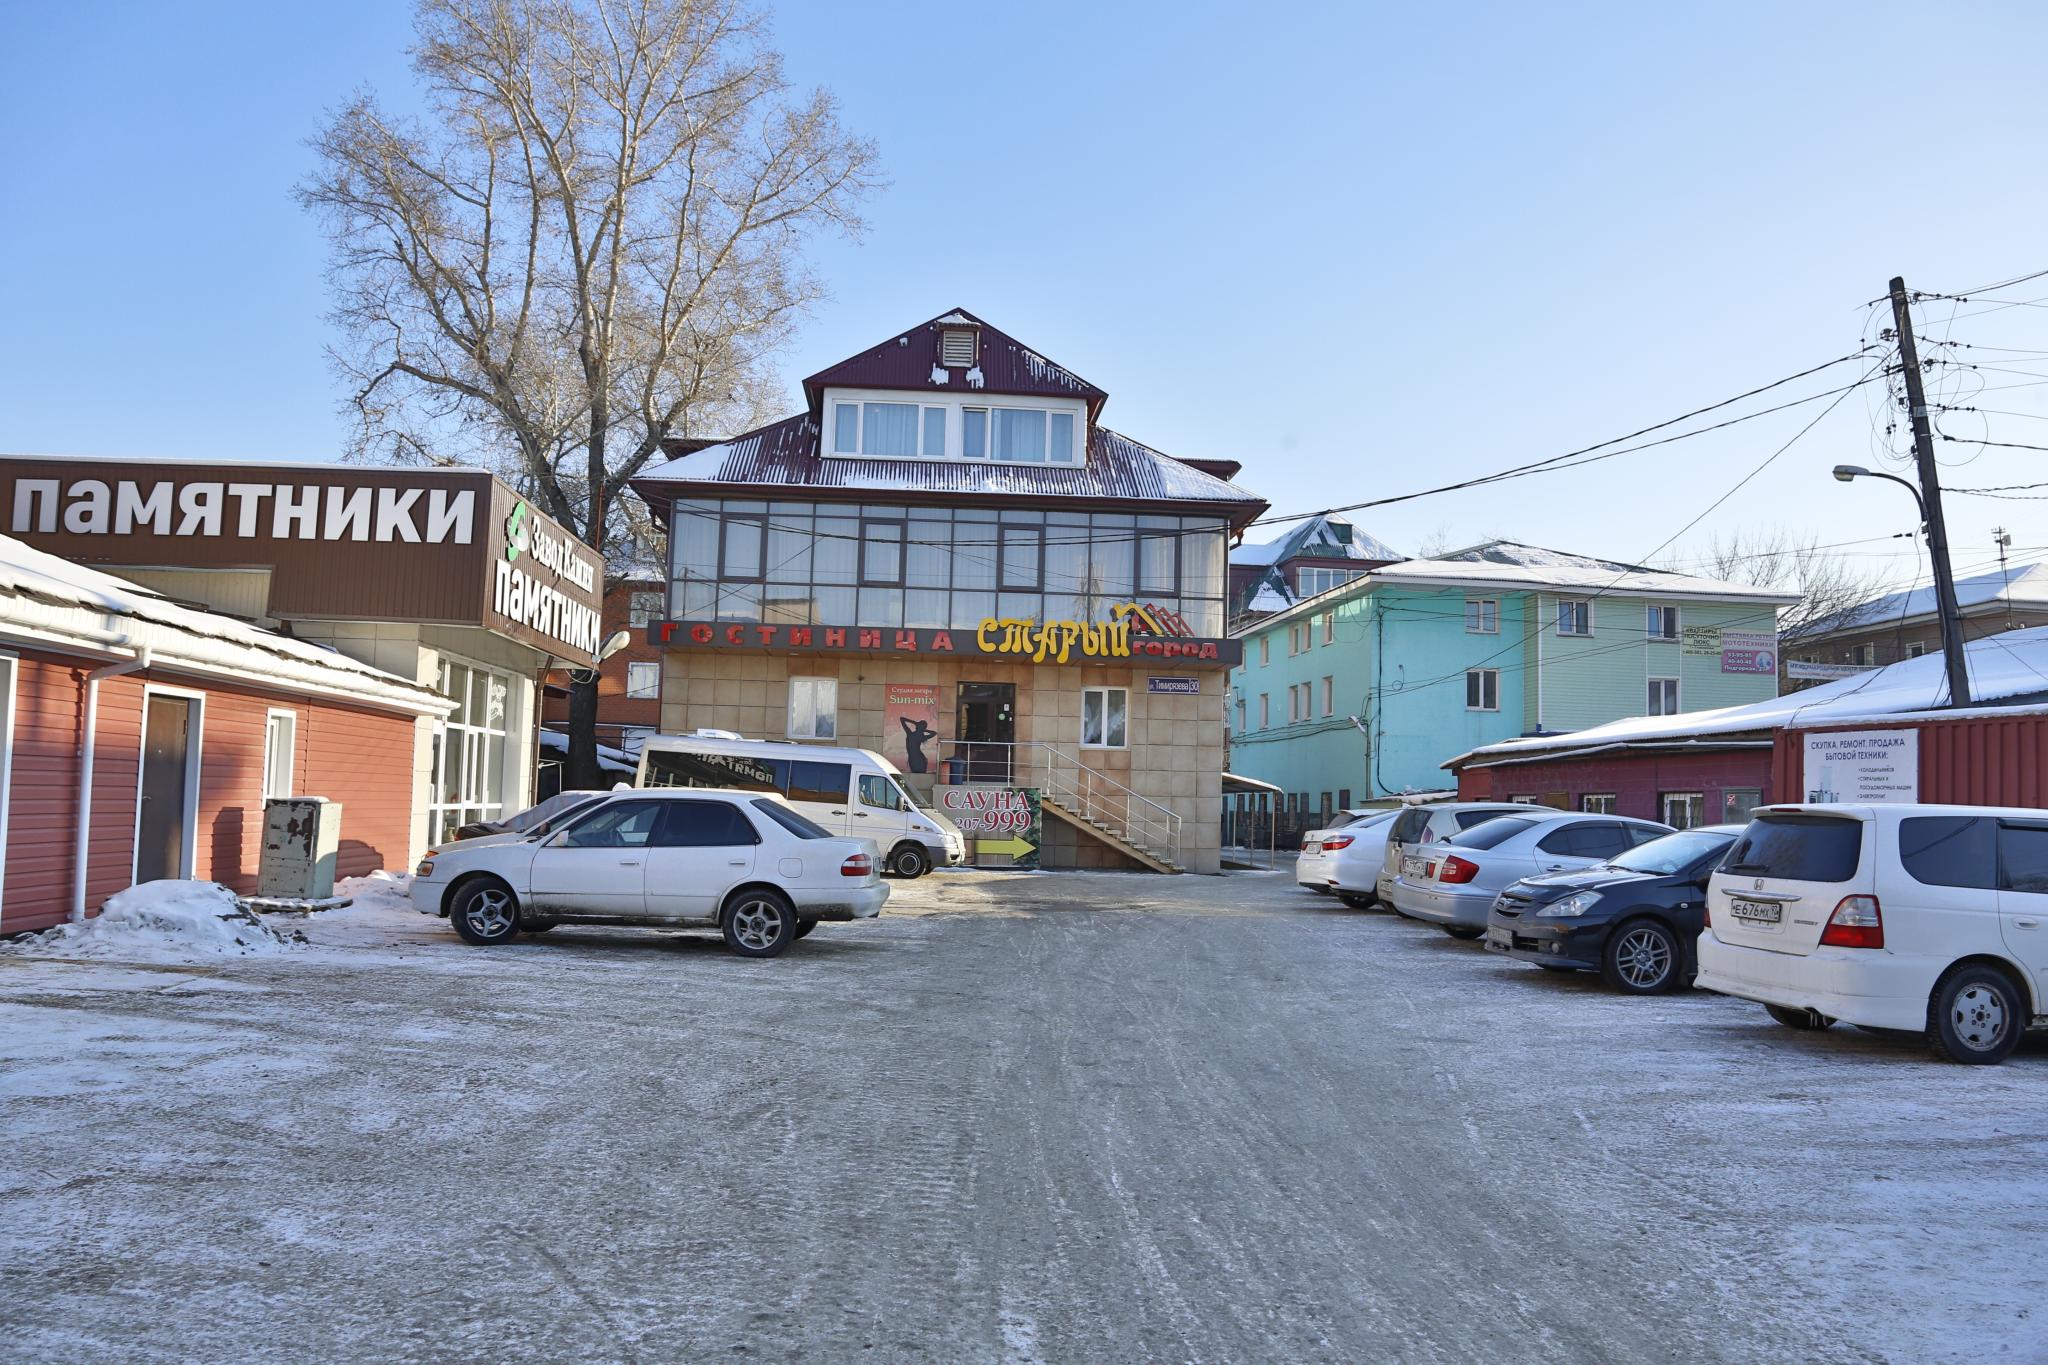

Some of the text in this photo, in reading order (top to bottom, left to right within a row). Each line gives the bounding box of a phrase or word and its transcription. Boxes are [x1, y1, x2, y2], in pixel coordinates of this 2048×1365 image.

[530, 515, 594, 593] Завод Камня
[660, 623, 953, 651] ГОСТИНИЦА
[1190, 680, 1198, 692] 30
[889, 694, 935, 705] Sun-mix
[1868, 738, 1905, 748] ПРОДАЖА
[1825, 750, 1856, 761] БЫТОВОЙ
[943, 790, 1031, 811] САУНА
[955, 810, 1032, 833] 207-999
